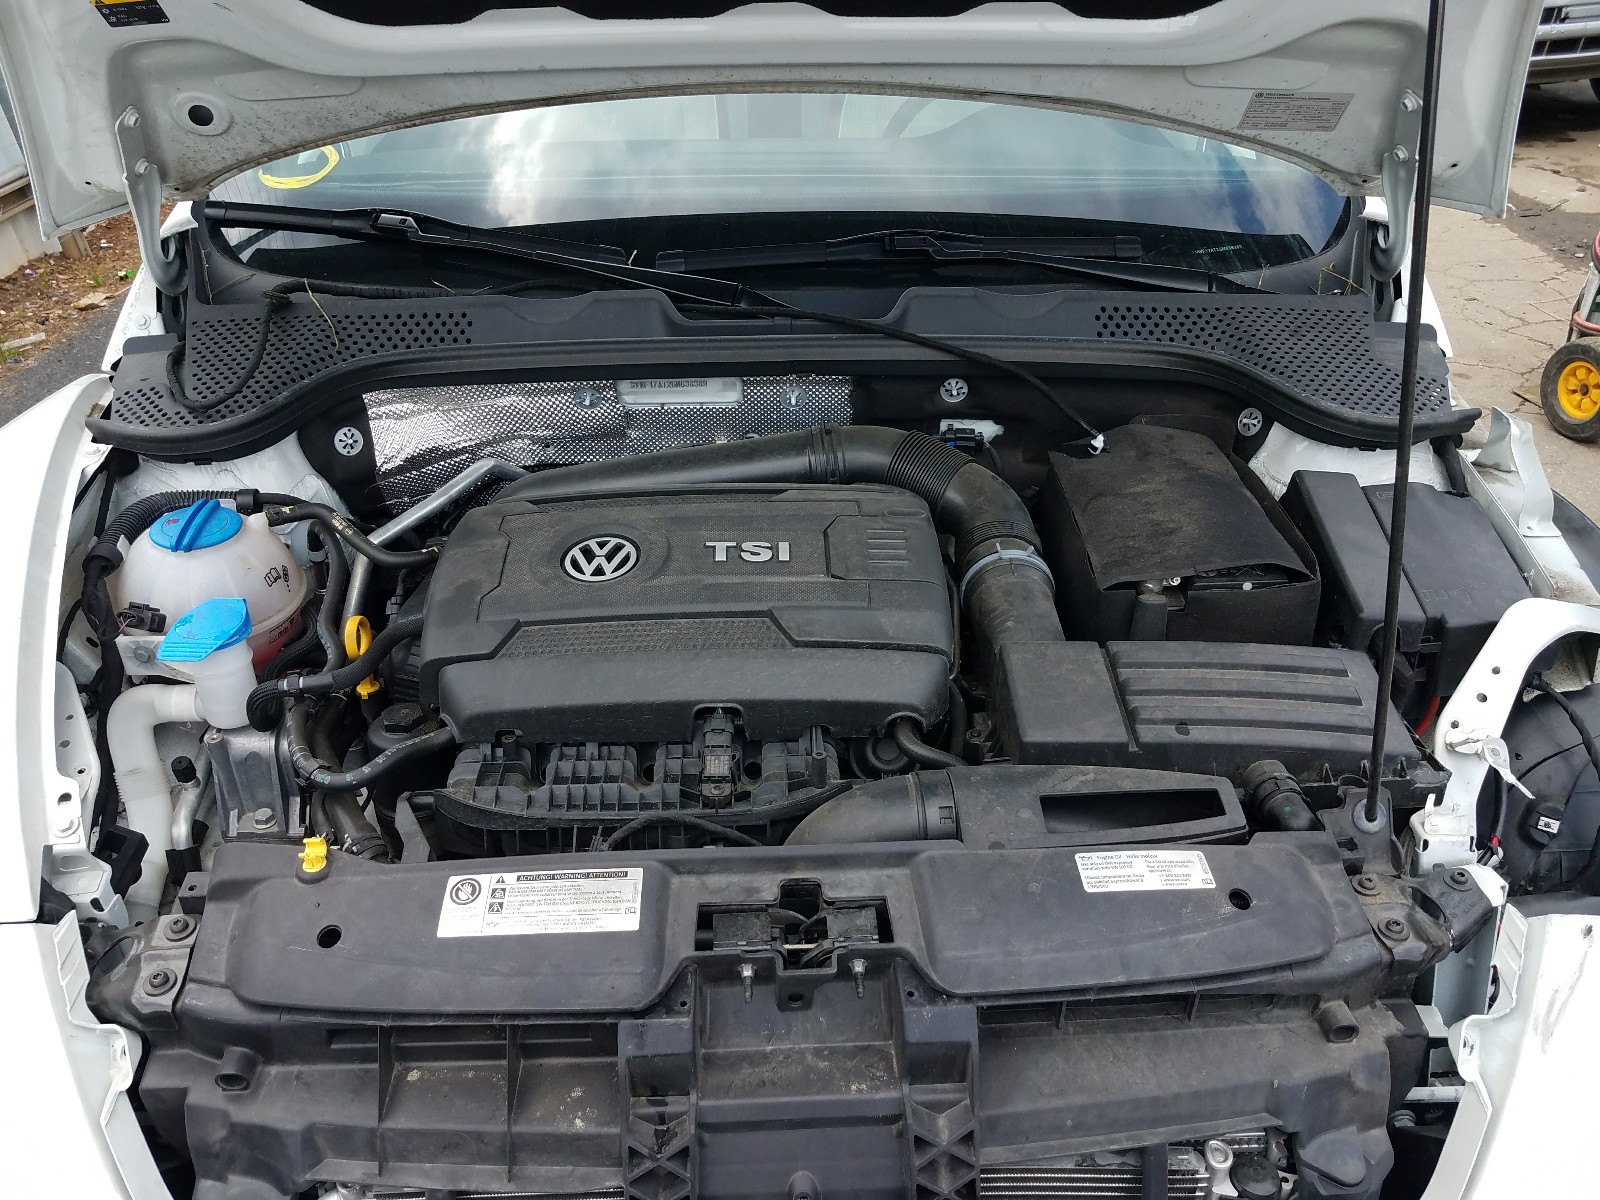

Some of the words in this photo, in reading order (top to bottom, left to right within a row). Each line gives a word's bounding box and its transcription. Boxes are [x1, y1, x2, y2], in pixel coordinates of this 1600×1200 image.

[705, 541, 790, 562] TSI
[519, 873, 554, 882] ACHTUNG!
[554, 872, 588, 880] WARNING!
[588, 871, 627, 879] ATTENTION!
